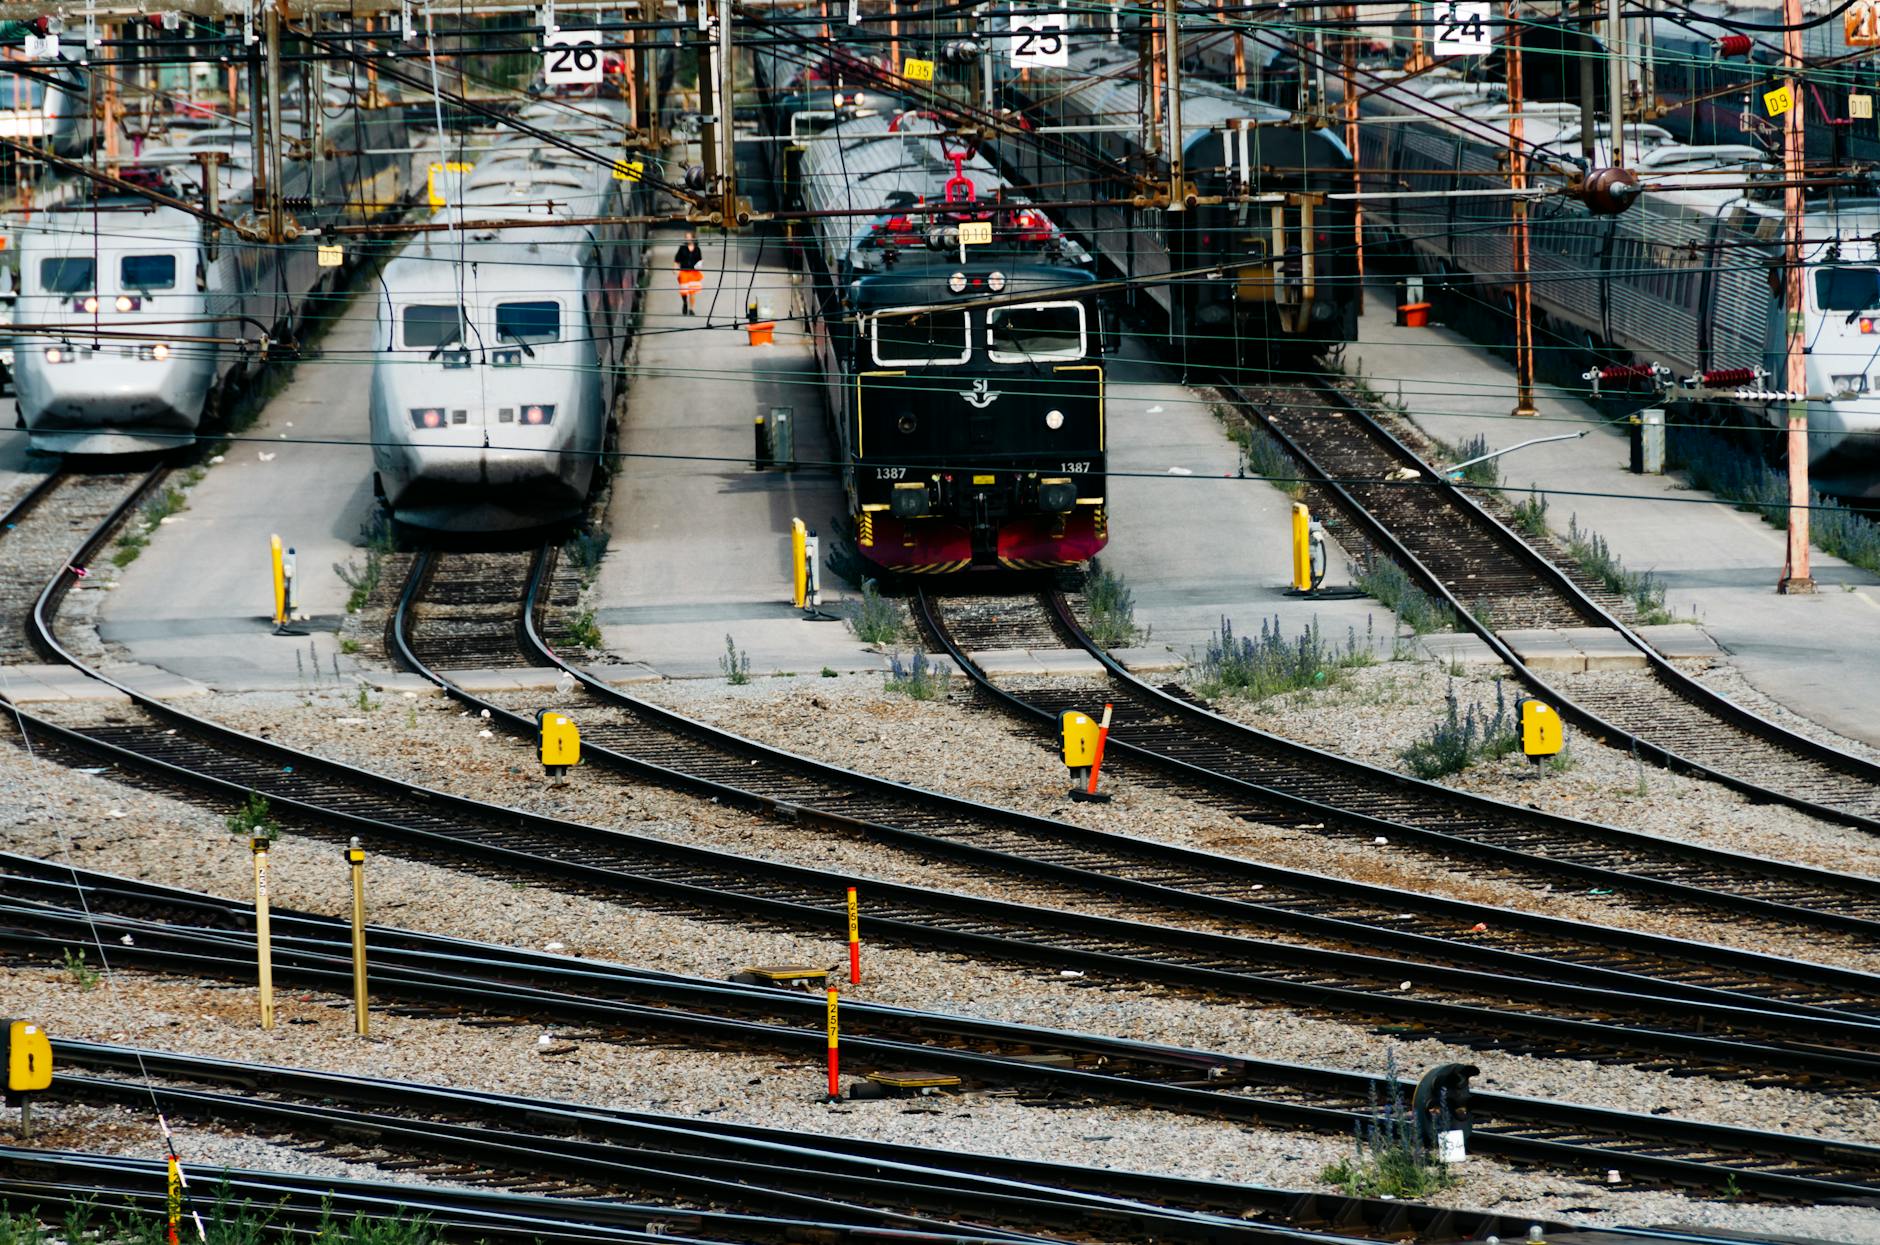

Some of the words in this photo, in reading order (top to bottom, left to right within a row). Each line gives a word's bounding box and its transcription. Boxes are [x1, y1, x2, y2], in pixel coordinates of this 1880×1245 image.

[1439, 13, 1484, 43] 24
[1015, 26, 1062, 56] 25
[551, 40, 597, 72] 26
[1770, 94, 1788, 111] D9
[973, 378, 988, 393] SJ
[876, 467, 906, 479] 1387
[1061, 462, 1090, 473] 1387
